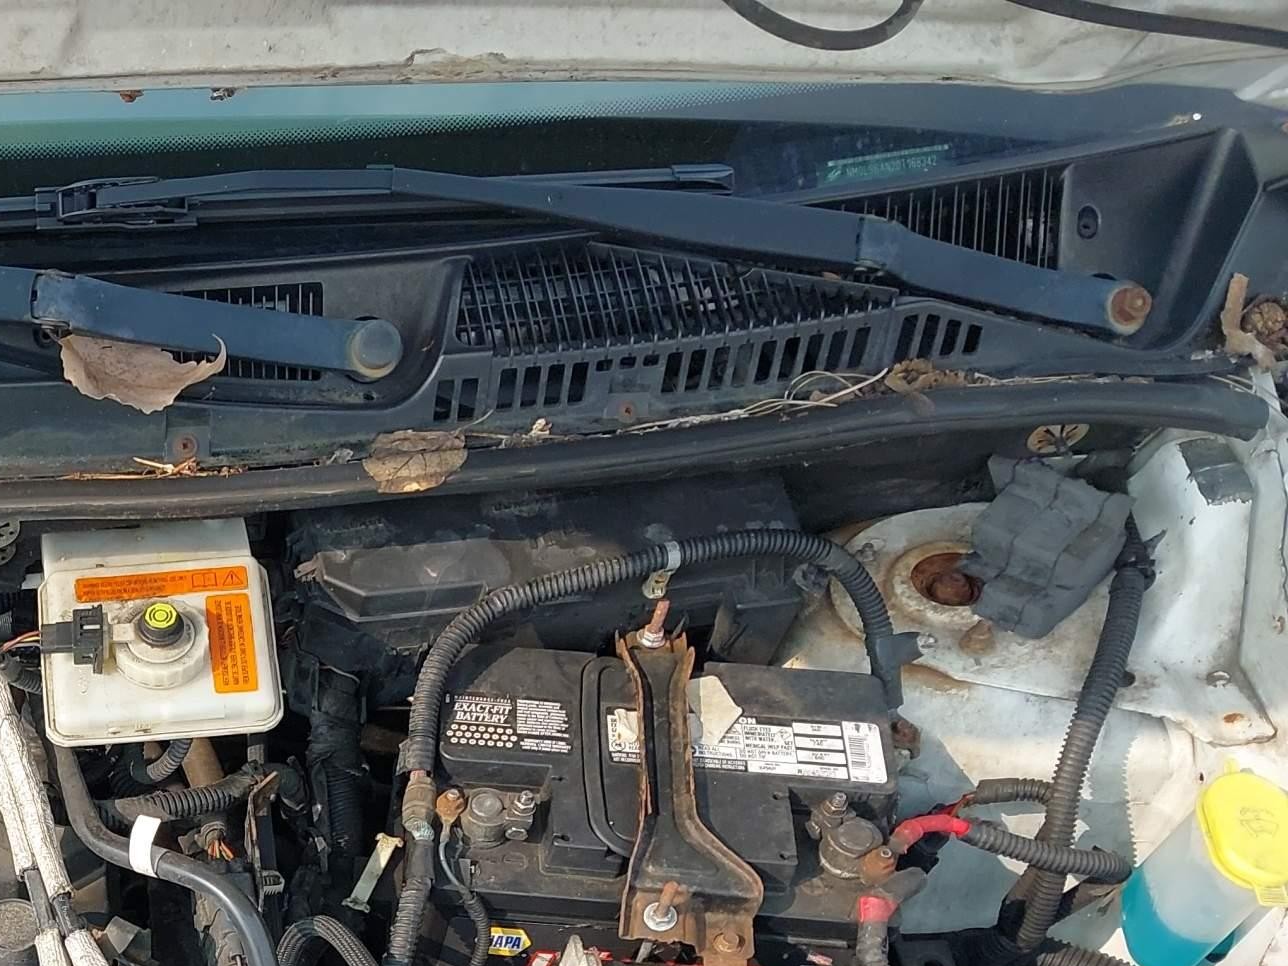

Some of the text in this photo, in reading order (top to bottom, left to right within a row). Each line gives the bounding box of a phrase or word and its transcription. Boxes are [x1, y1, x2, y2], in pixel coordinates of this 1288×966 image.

[454, 702, 513, 715] EXACT-FIT
[455, 711, 508, 724] BATTERY
[490, 935, 522, 949] APA
